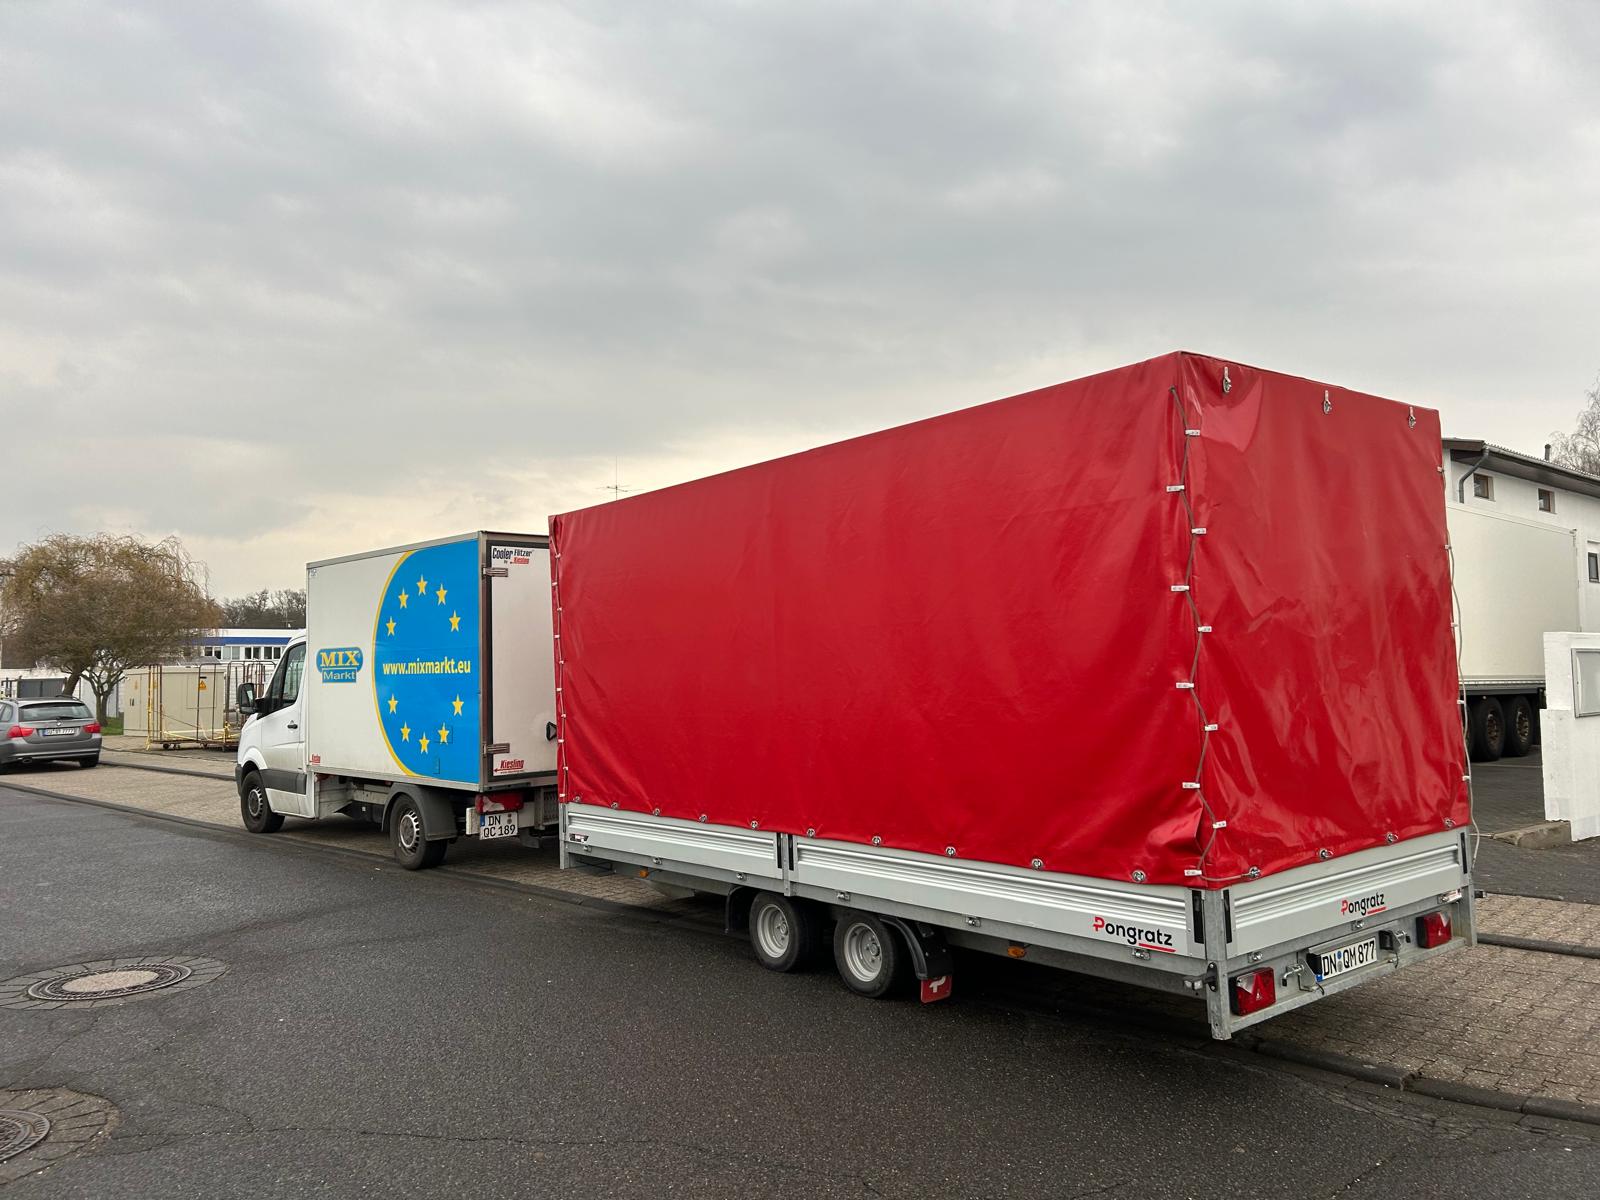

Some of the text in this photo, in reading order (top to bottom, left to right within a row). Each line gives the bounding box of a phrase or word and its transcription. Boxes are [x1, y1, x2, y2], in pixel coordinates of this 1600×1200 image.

[492, 547, 513, 559] Cooler
[320, 650, 359, 667] MIX
[383, 656, 471, 675] www.mixmarkt.eu
[323, 671, 356, 680] Markt
[500, 759, 524, 769] Kiesling
[488, 815, 501, 826] DN
[483, 824, 516, 838] QC 189
[1341, 892, 1385, 916] Pongratz
[1093, 916, 1173, 946] Pongratz
[1322, 940, 1375, 976] DN QM 877
